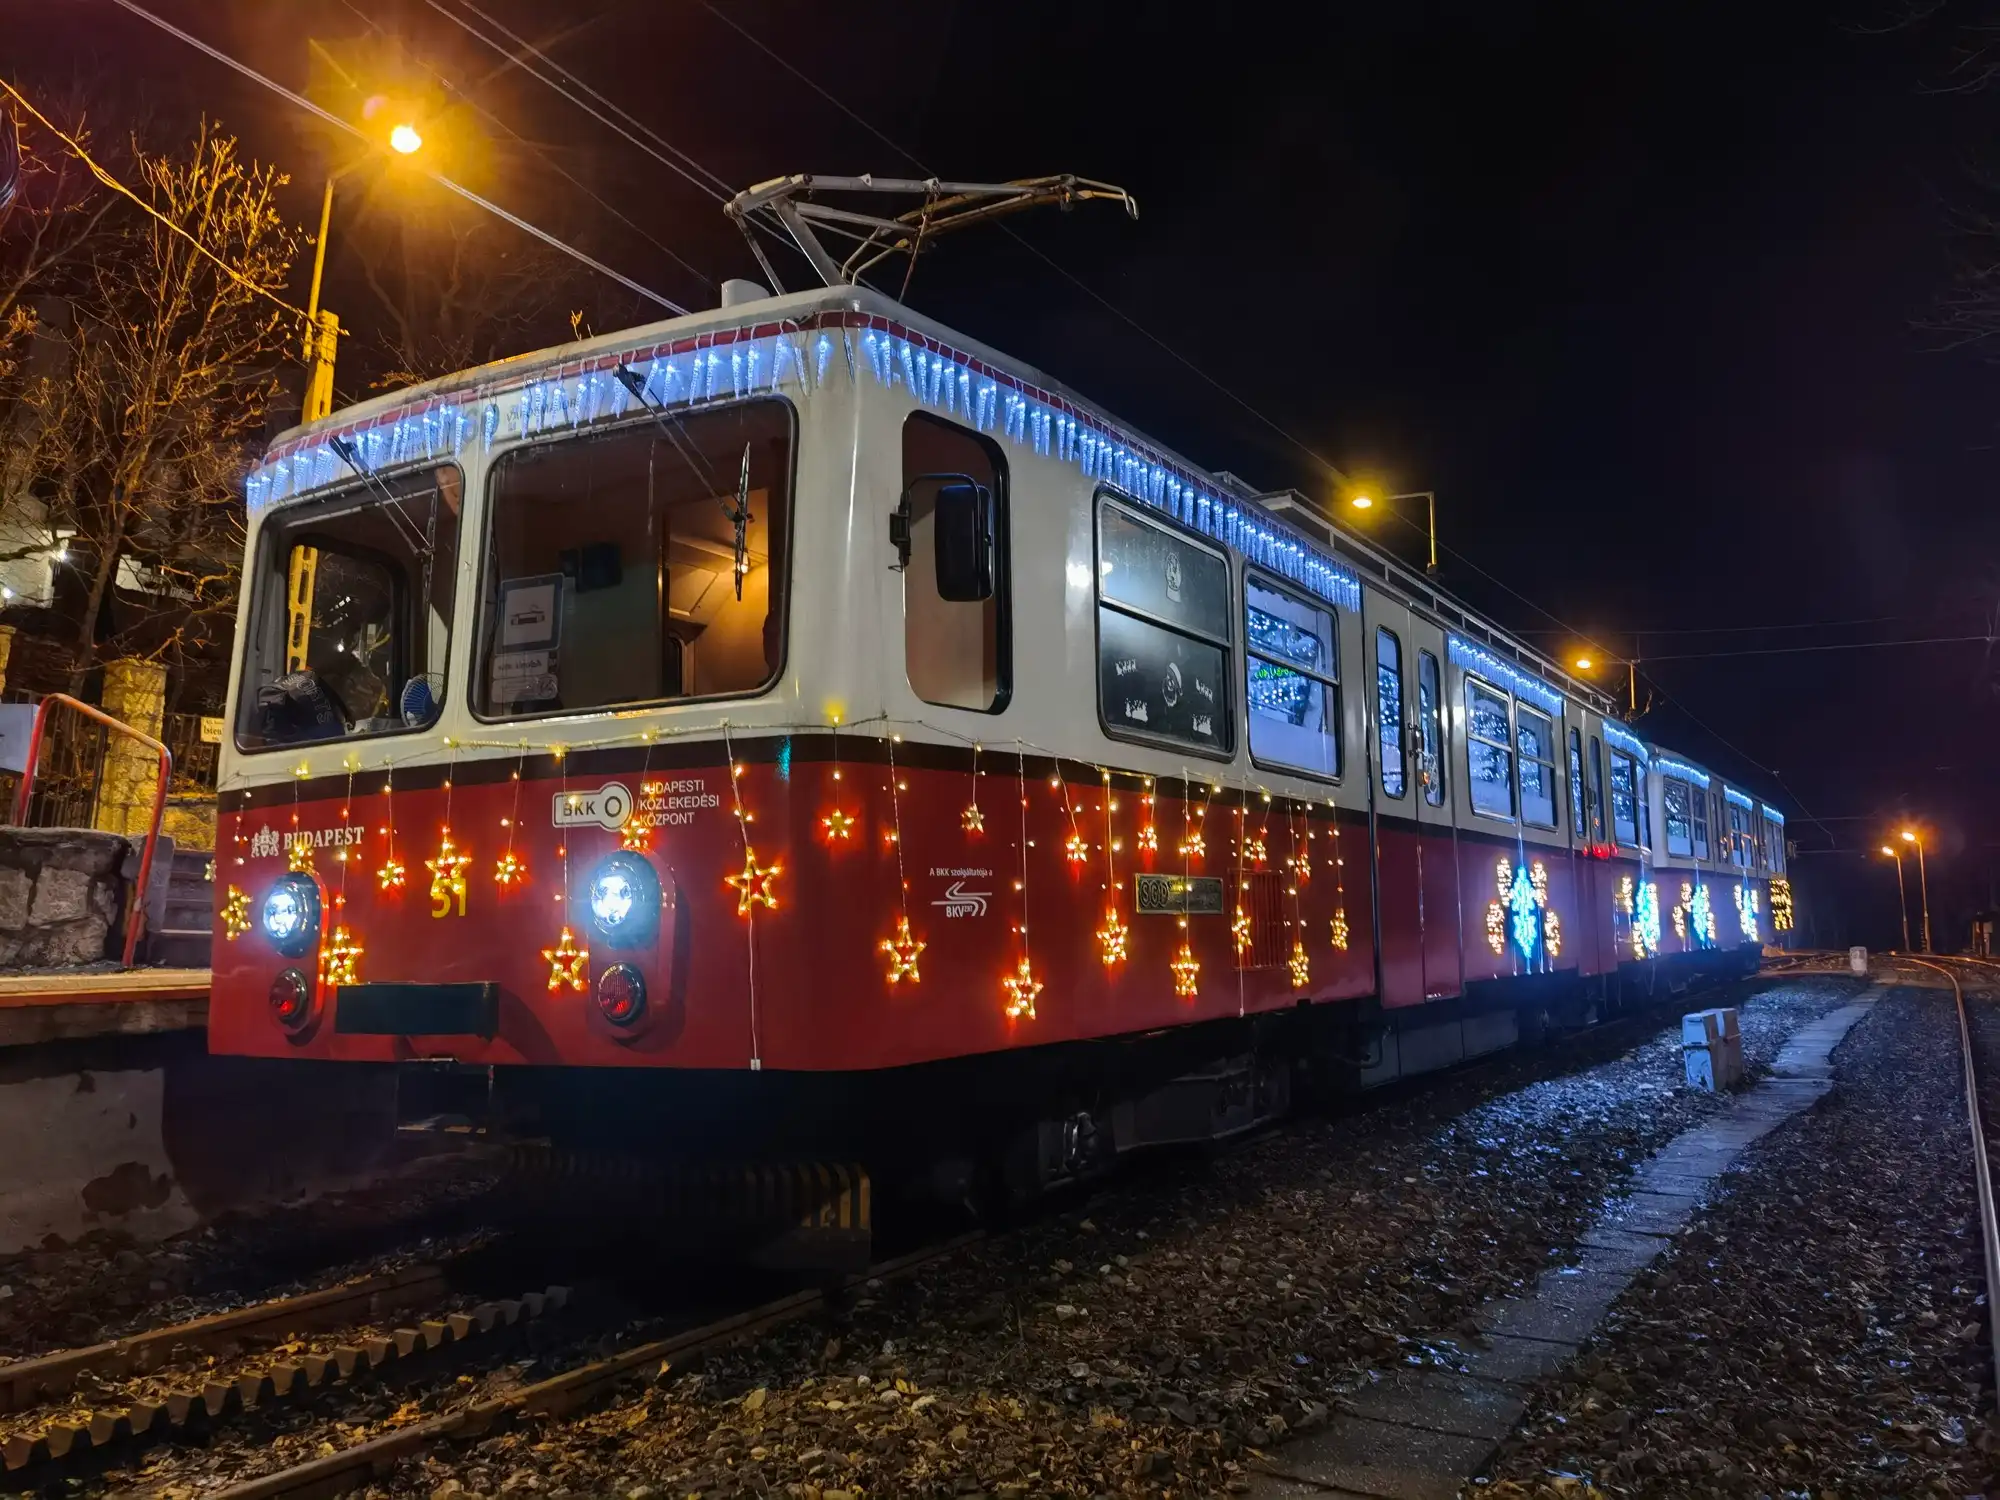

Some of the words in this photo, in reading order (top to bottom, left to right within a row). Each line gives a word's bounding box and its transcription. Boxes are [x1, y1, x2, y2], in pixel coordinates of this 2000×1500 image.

[640, 779, 705, 796] BUDAPESTI
[563, 800, 596, 817] BKK
[283, 826, 365, 850] BUDAPEST
[929, 867, 935, 876] A
[936, 867, 950, 876] BKK
[430, 878, 467, 918] 51
